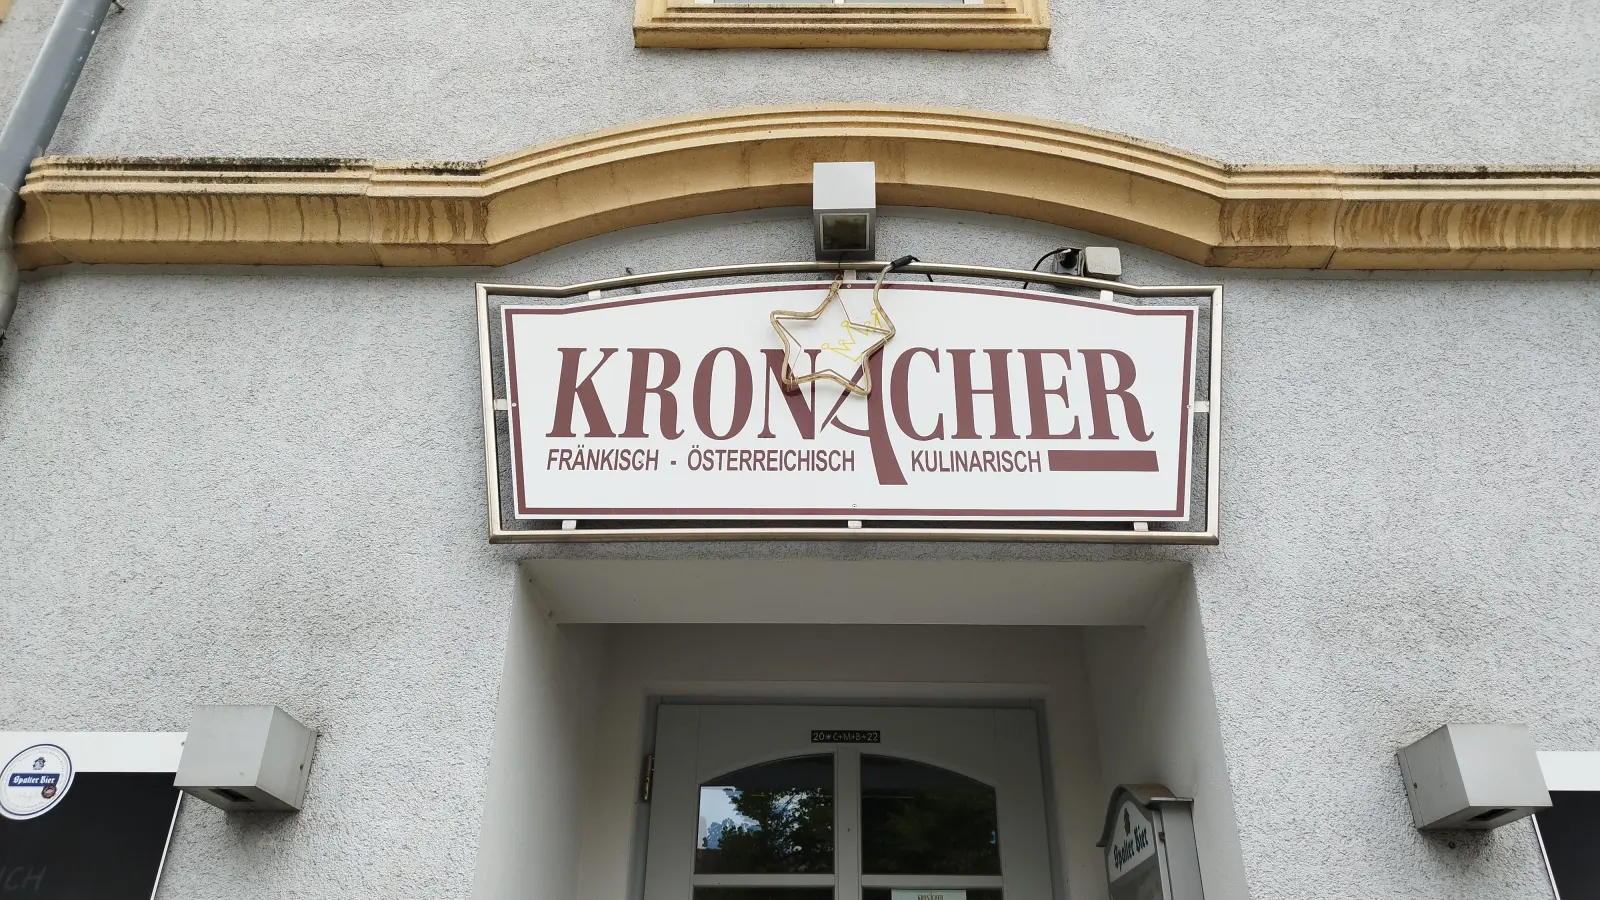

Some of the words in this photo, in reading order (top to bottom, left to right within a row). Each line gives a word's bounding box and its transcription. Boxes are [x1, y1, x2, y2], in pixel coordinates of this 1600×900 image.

[545, 346, 1154, 485] KRONACHER
[546, 444, 659, 471] FRÄNKISCH
[687, 445, 855, 472] ÖSTERREICHISCH
[911, 450, 1042, 472] KULINARISCH
[40, 774, 56, 784] Bier
[1133, 824, 1149, 853] Bier
